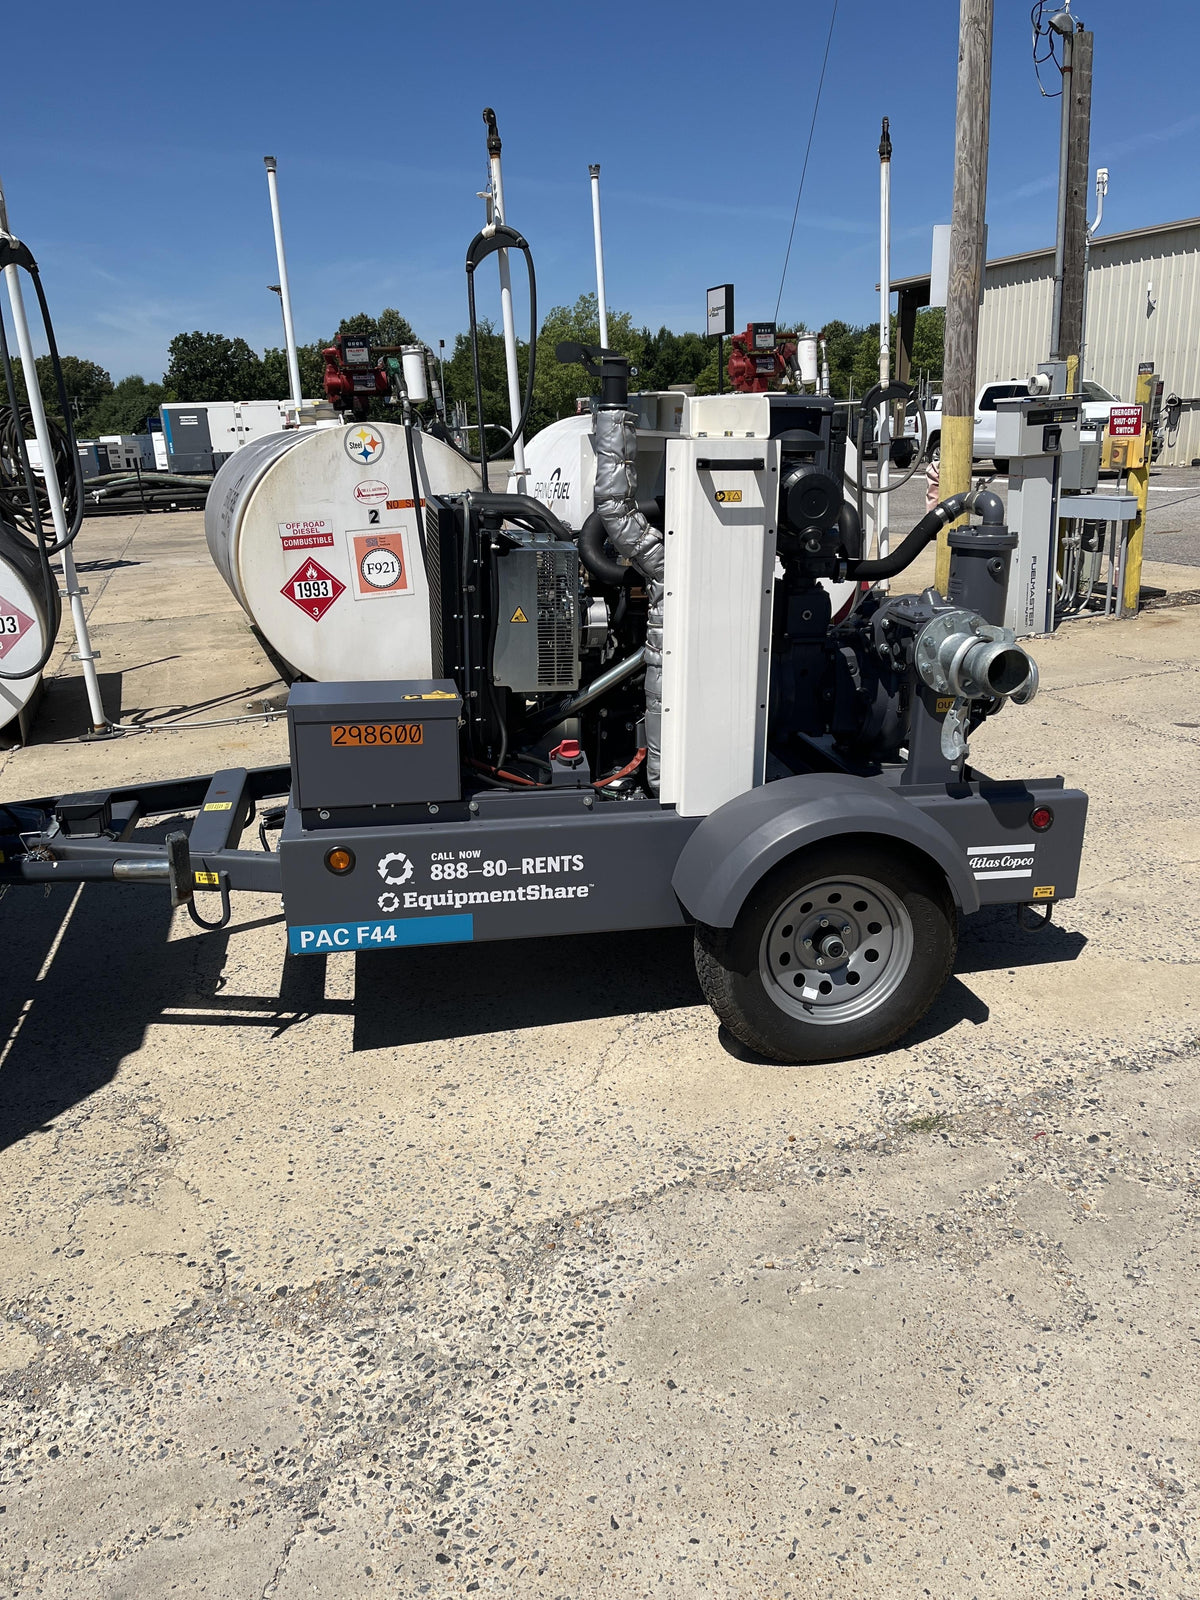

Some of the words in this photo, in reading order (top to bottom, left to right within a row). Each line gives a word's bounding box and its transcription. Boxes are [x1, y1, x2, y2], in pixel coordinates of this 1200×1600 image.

[1111, 408, 1141, 416] EMERGENCY
[1113, 417, 1137, 425] SHUT-OFF
[1115, 426, 1135, 434] SWITCH
[349, 441, 363, 449] Steel
[552, 481, 571, 499] FUEL
[386, 501, 399, 509] NO
[369, 510, 380, 524] 2
[285, 522, 301, 530] OFF
[302, 520, 325, 528] ROAD
[292, 527, 320, 535] DIESEL
[283, 536, 333, 547] COMBUSTIBLE
[366, 560, 396, 575] F921
[296, 580, 329, 598] 1993
[1028, 555, 1037, 627] FUELMASTER
[312, 606, 319, 616] 3
[937, 701, 953, 709] OU
[333, 724, 422, 745] 298600
[431, 851, 455, 861] CALL
[459, 849, 481, 860] NOW
[968, 857, 1001, 869] Atlas
[1000, 855, 1034, 869] Copco
[300, 928, 350, 949] PAC
[356, 925, 398, 945] F44
